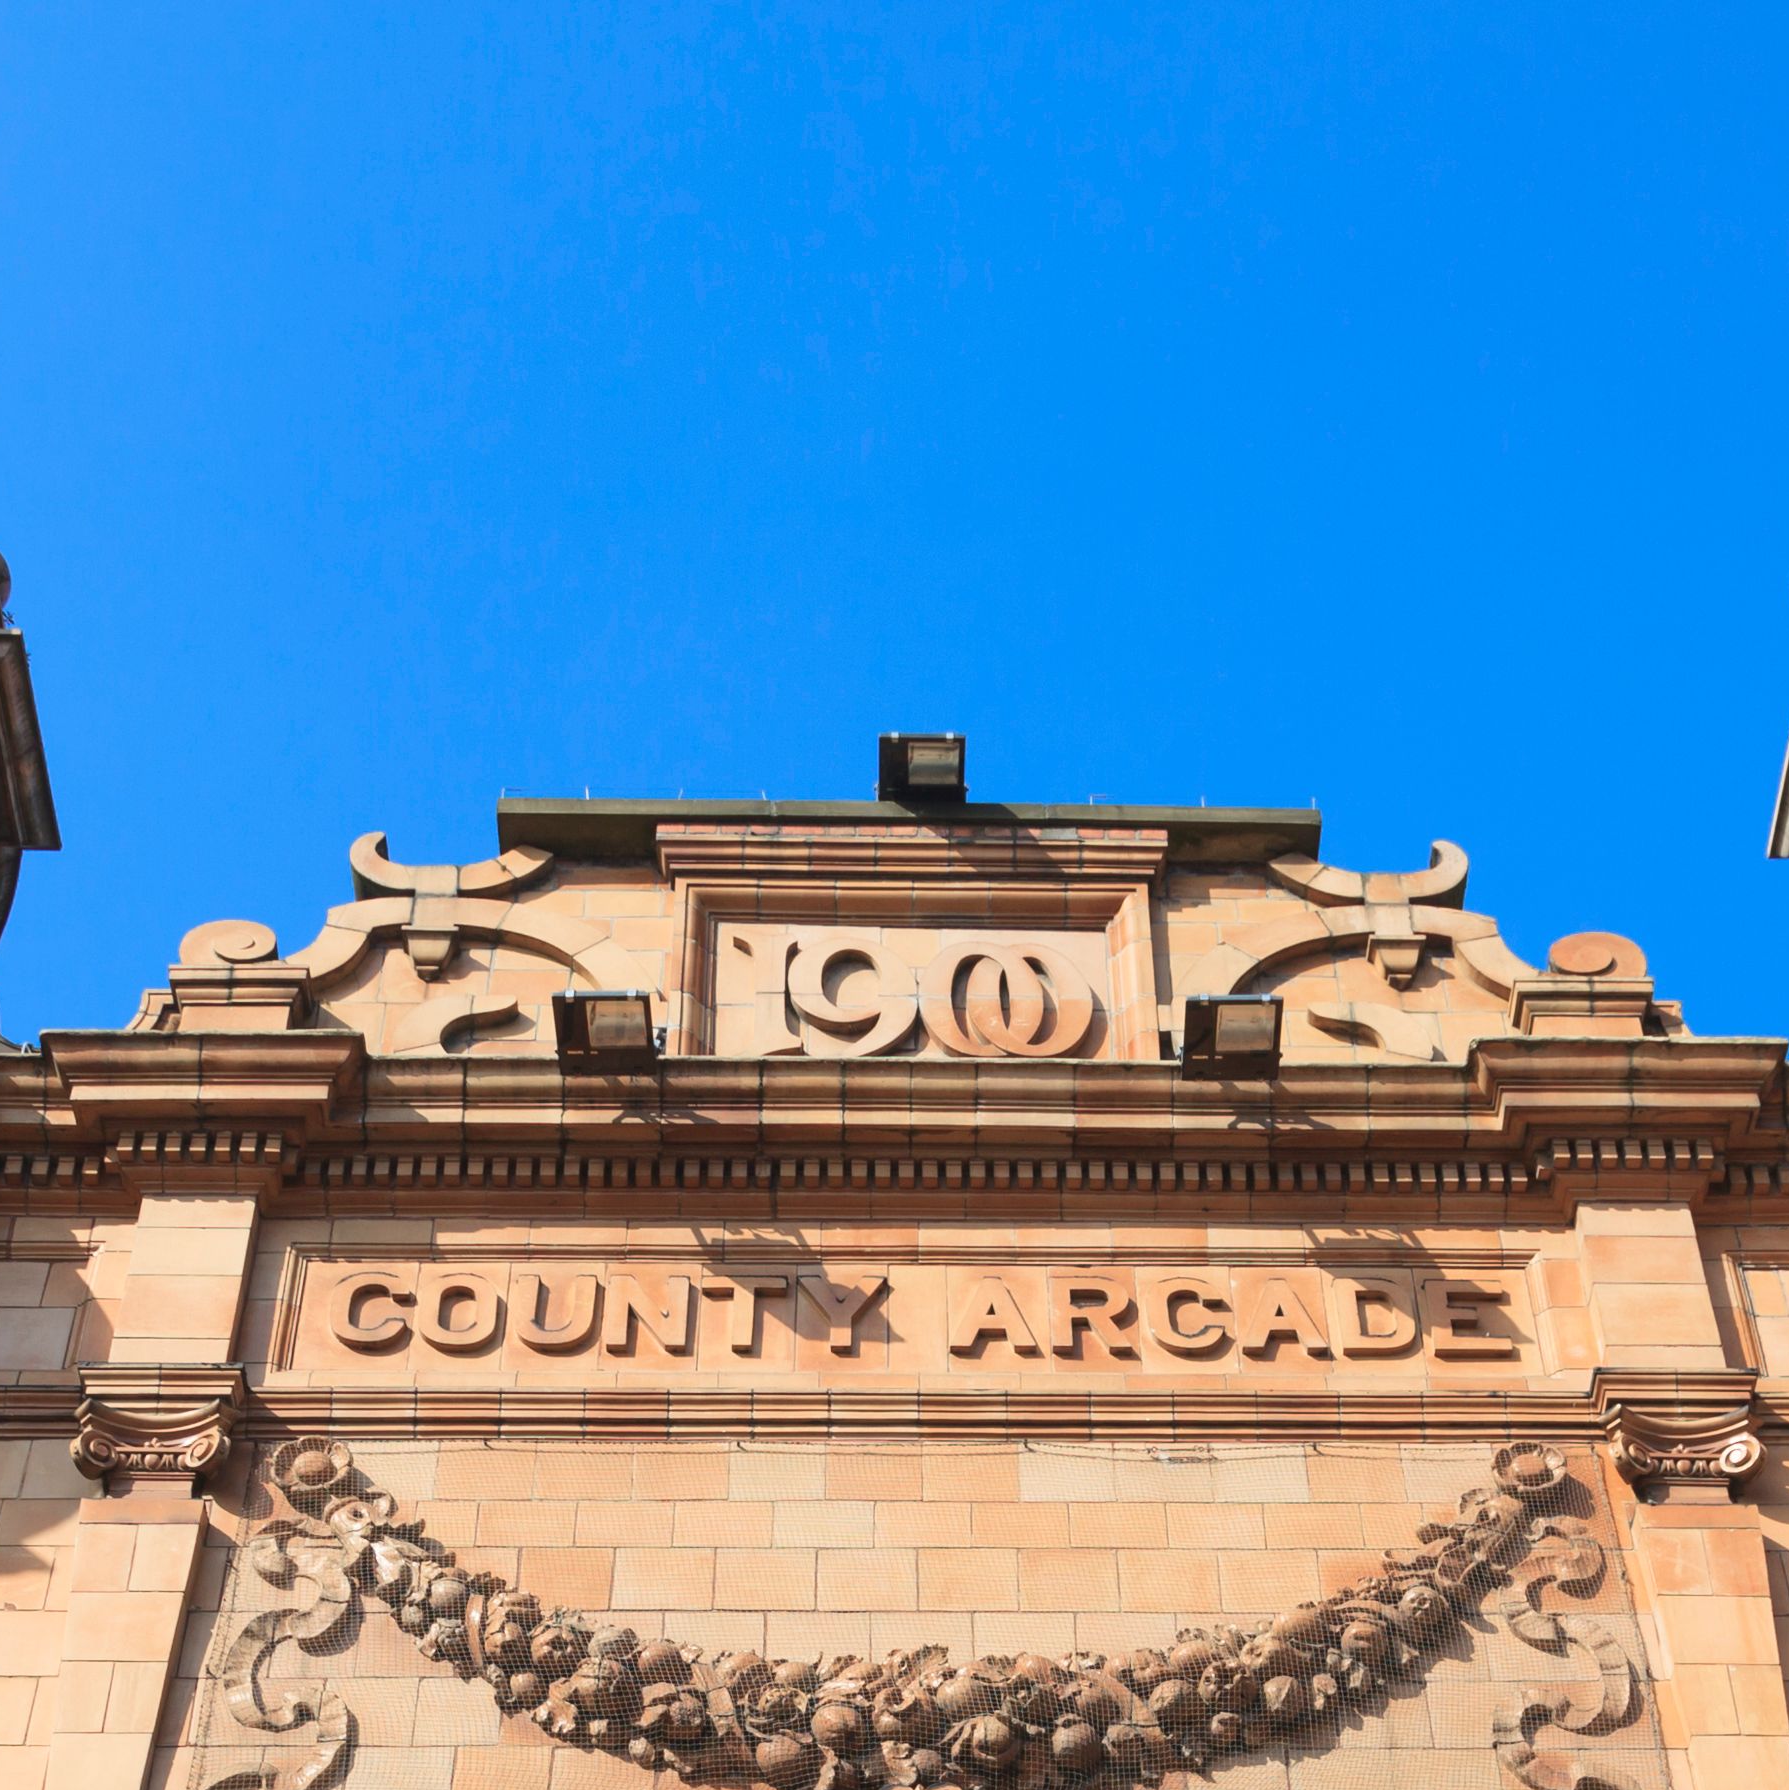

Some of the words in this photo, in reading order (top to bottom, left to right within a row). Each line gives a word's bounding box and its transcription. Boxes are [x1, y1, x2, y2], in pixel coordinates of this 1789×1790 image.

[731, 935, 1096, 1058] 1900
[329, 1272, 890, 1358] COUNTY
[949, 1275, 1514, 1360] ARCADE
